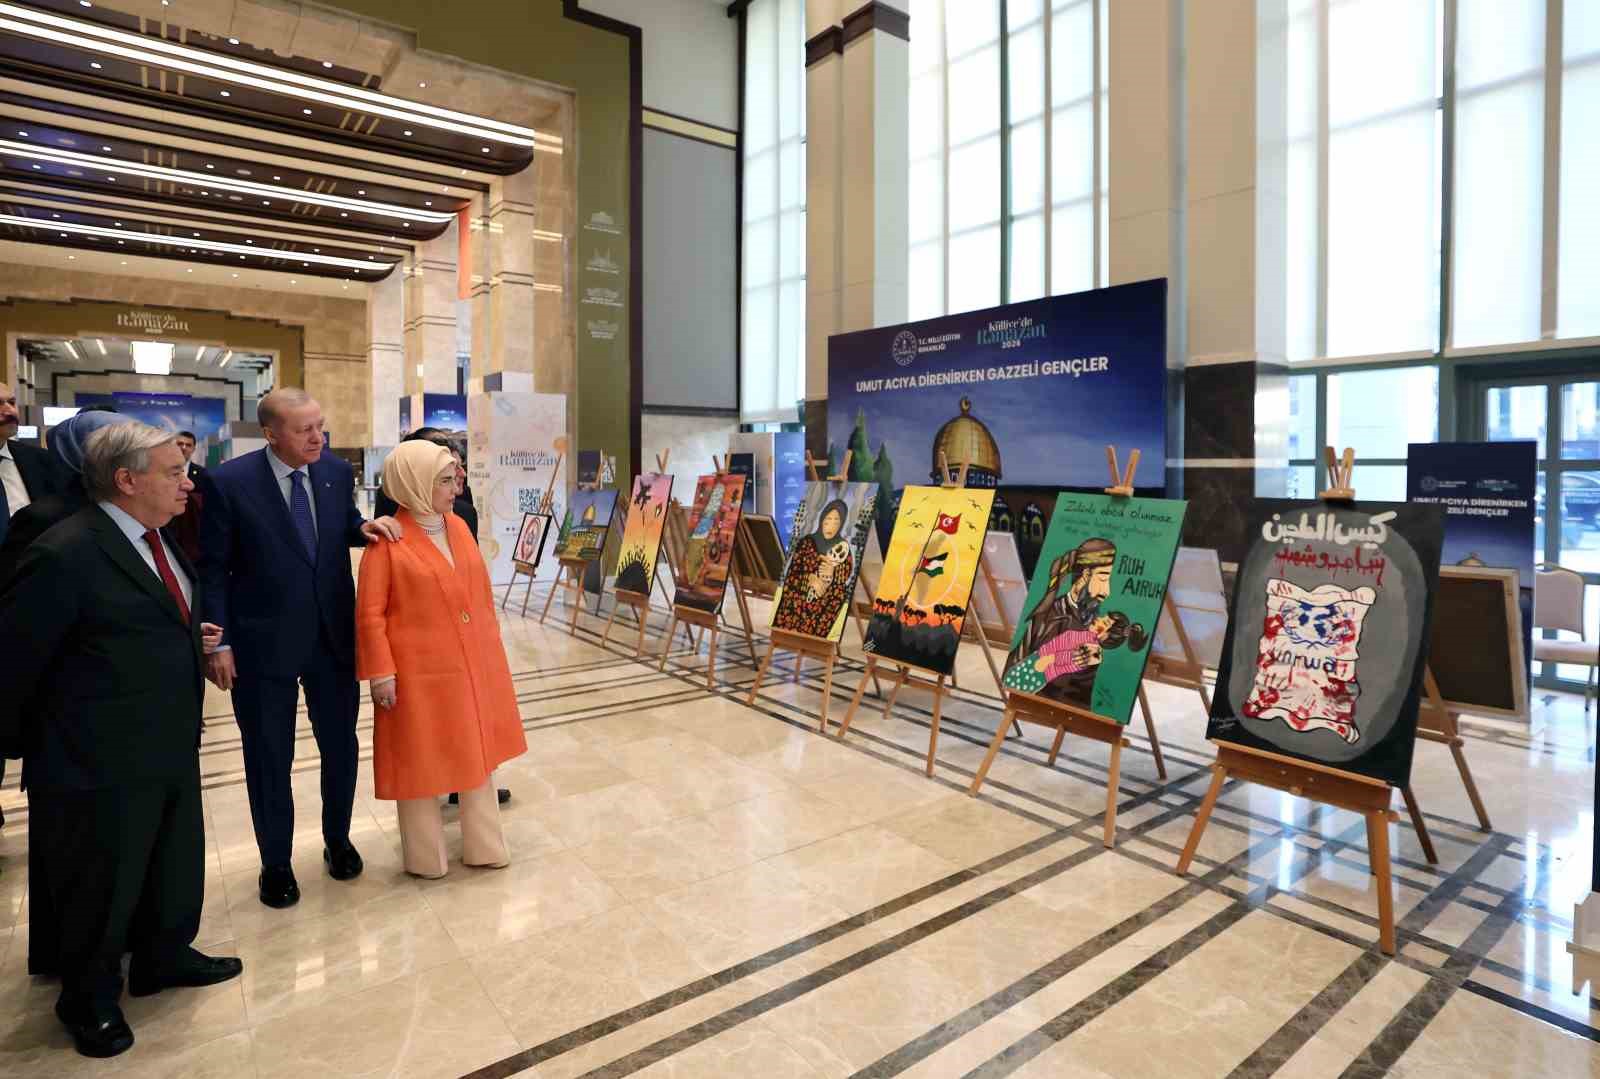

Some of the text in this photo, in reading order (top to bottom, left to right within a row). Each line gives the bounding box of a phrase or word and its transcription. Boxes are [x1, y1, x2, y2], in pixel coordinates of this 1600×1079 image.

[856, 356, 1110, 393] UMUT ACIYA DİRENİRKEN GAZZELİ GENÇLER
[1333, 510, 1398, 550] كيس
[1117, 554, 1146, 577] RUH
